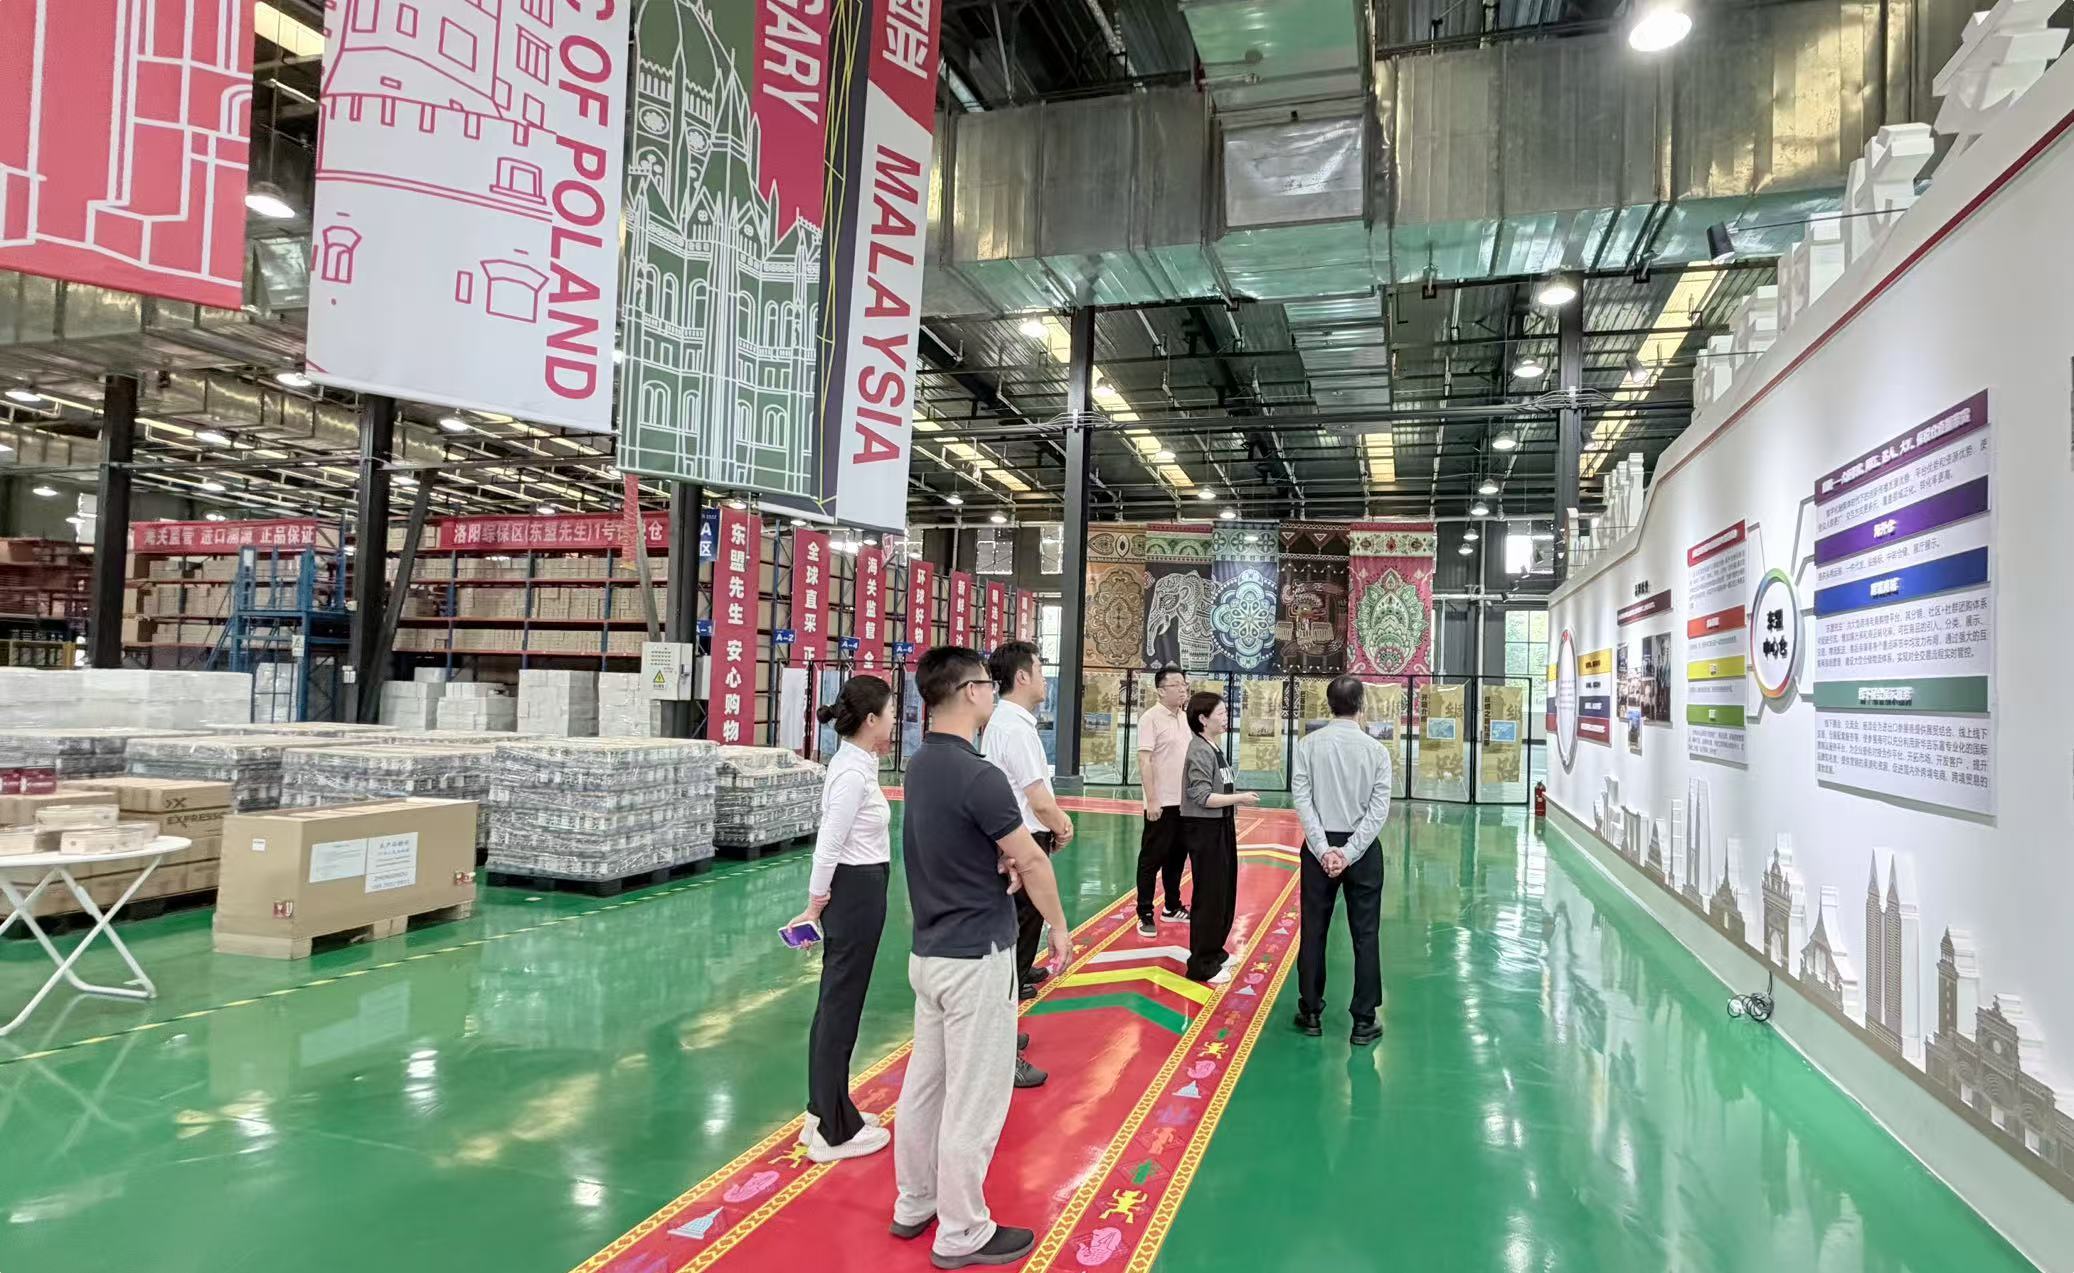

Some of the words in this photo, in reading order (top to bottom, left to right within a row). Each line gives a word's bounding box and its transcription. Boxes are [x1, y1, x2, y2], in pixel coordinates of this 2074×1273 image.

[558, 34, 613, 128] OF
[543, 134, 608, 400] POLAND
[851, 142, 922, 465] MALAYSIA
[260, 525, 316, 545] 正品保证
[727, 522, 747, 626] 东盟先生
[804, 541, 820, 633] 全球直采
[722, 639, 743, 743] 安心购物
